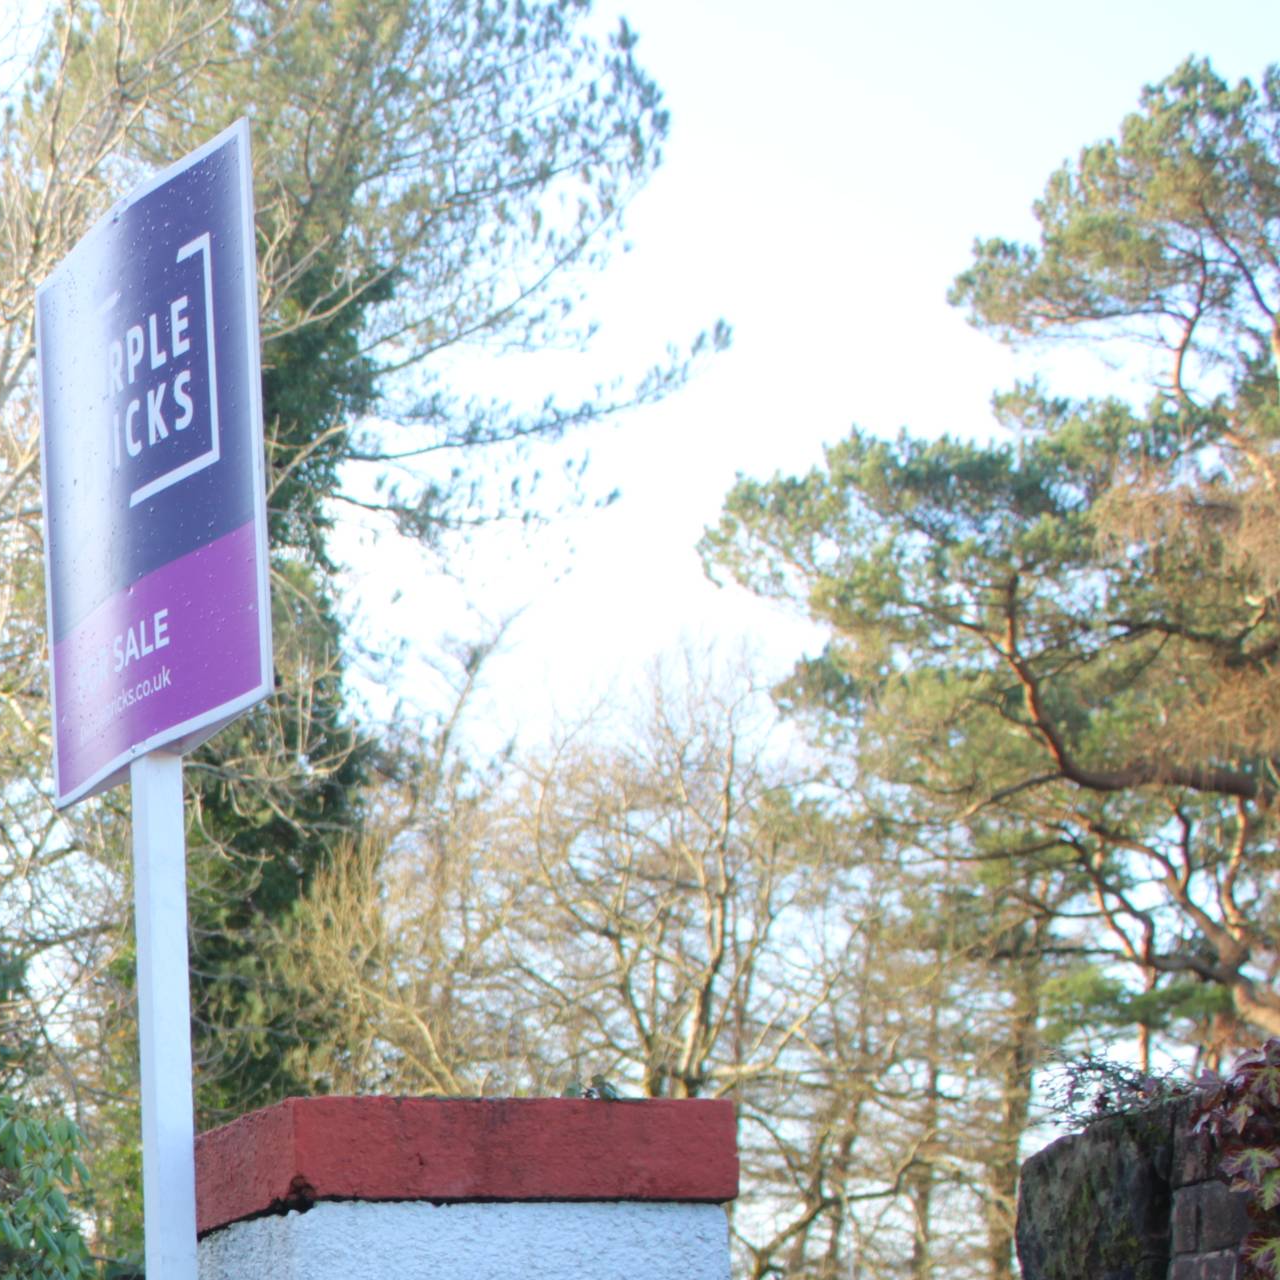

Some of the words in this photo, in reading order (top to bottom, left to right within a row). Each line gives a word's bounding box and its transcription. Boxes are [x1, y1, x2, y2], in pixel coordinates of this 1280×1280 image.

[108, 294, 192, 398] RPLE
[113, 367, 195, 467] ICKS
[112, 607, 171, 673] SALE
